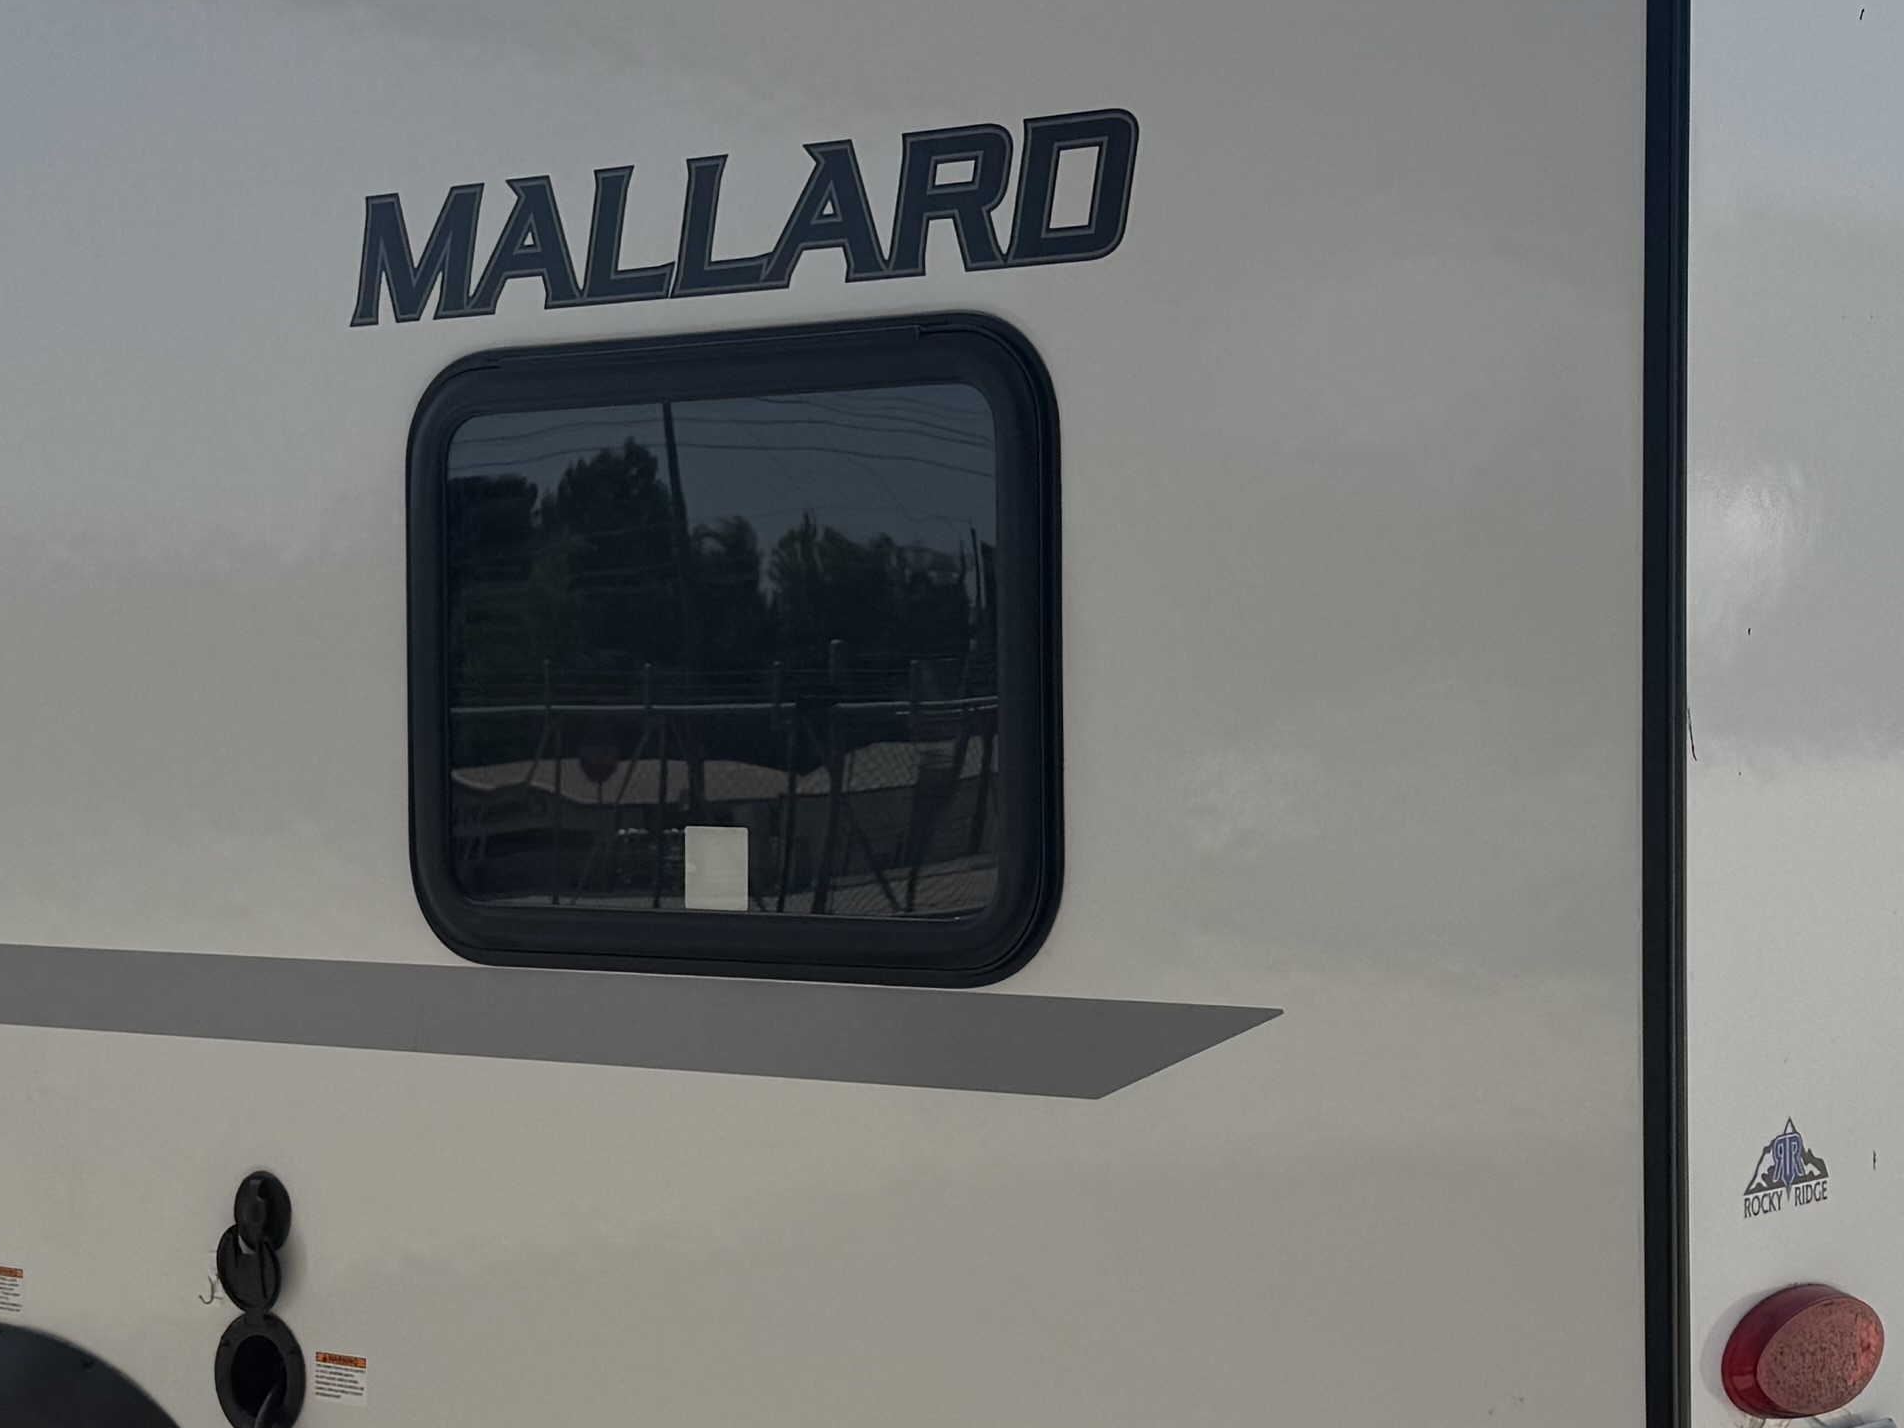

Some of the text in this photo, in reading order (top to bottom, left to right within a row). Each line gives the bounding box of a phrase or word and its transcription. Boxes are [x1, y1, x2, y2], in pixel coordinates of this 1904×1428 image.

[350, 108, 1139, 327] MALLARD
[1744, 1180, 1828, 1218] ROCKY RIDGE
